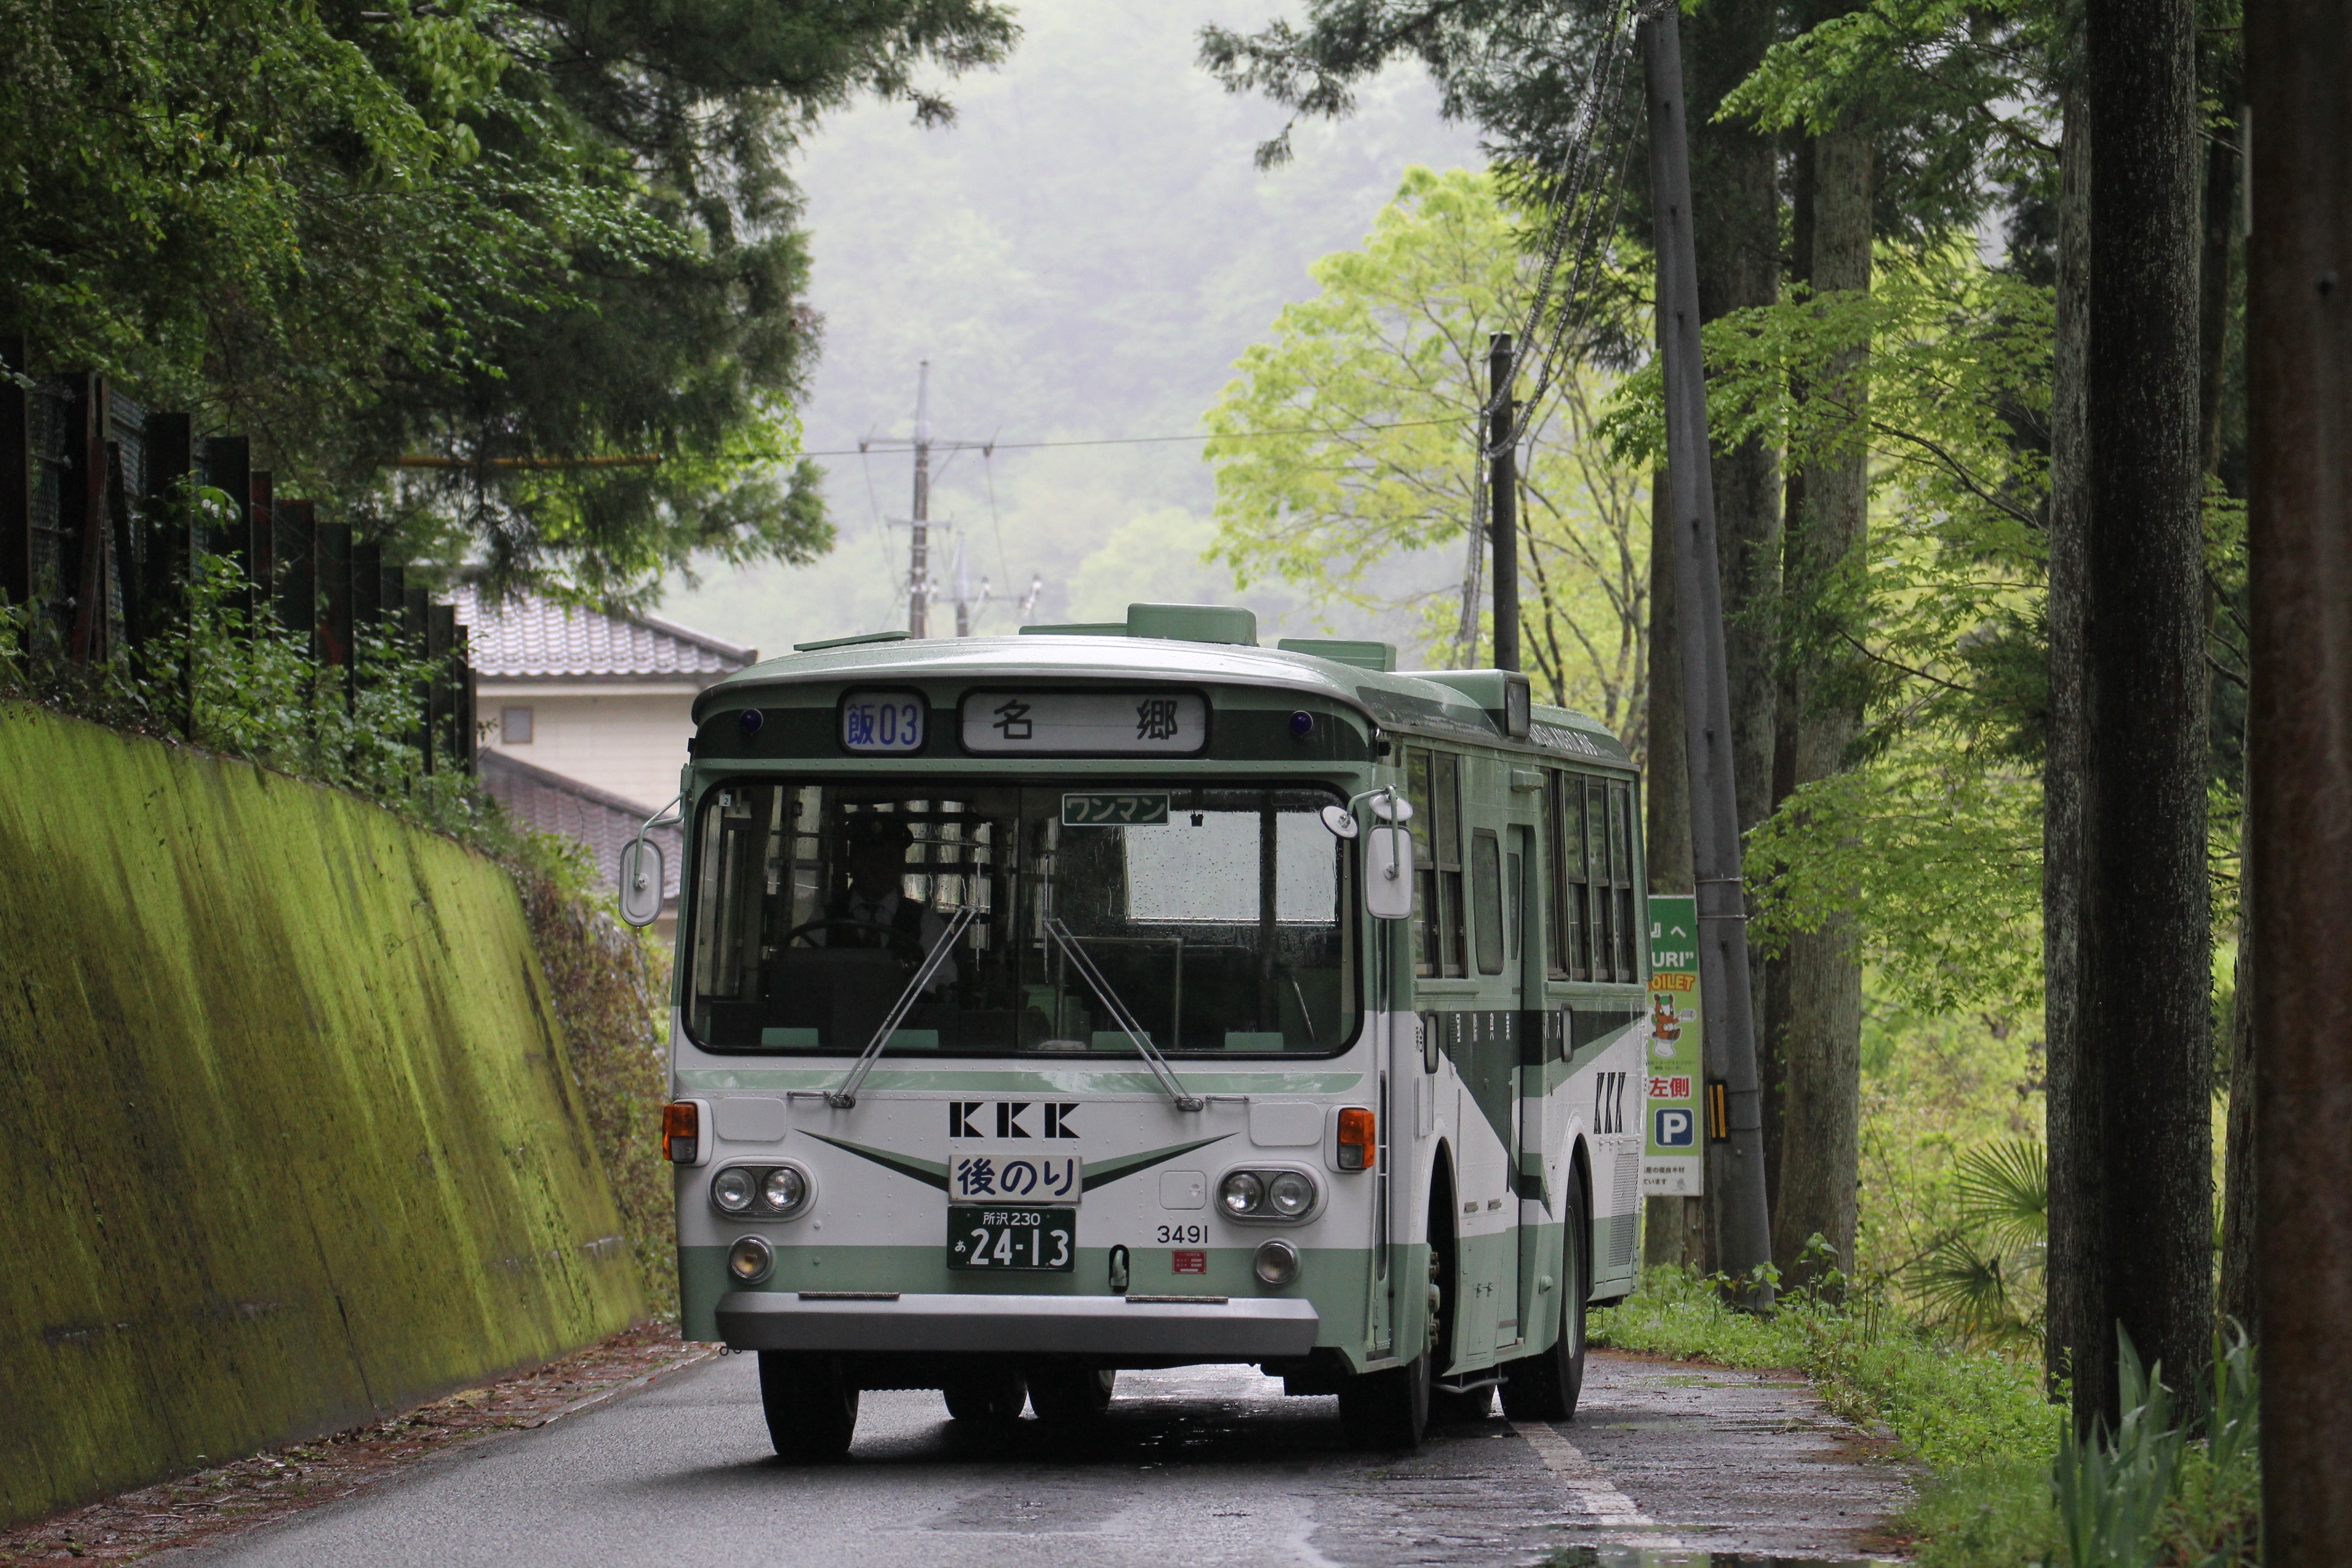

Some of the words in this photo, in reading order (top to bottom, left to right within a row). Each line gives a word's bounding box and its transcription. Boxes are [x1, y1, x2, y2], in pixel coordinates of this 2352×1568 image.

[847, 704, 917, 745] 飯03
[1066, 797, 1166, 821] ワンマン
[1649, 1077, 1689, 1097] 左側
[949, 1102, 1081, 1139] KKK
[1663, 1113, 1687, 1143] P
[957, 1158, 1073, 1197] 後のり
[955, 1240, 966, 1253] あ
[970, 1228, 1069, 1266] 24-13
[1157, 1225, 1208, 1244] 3491
